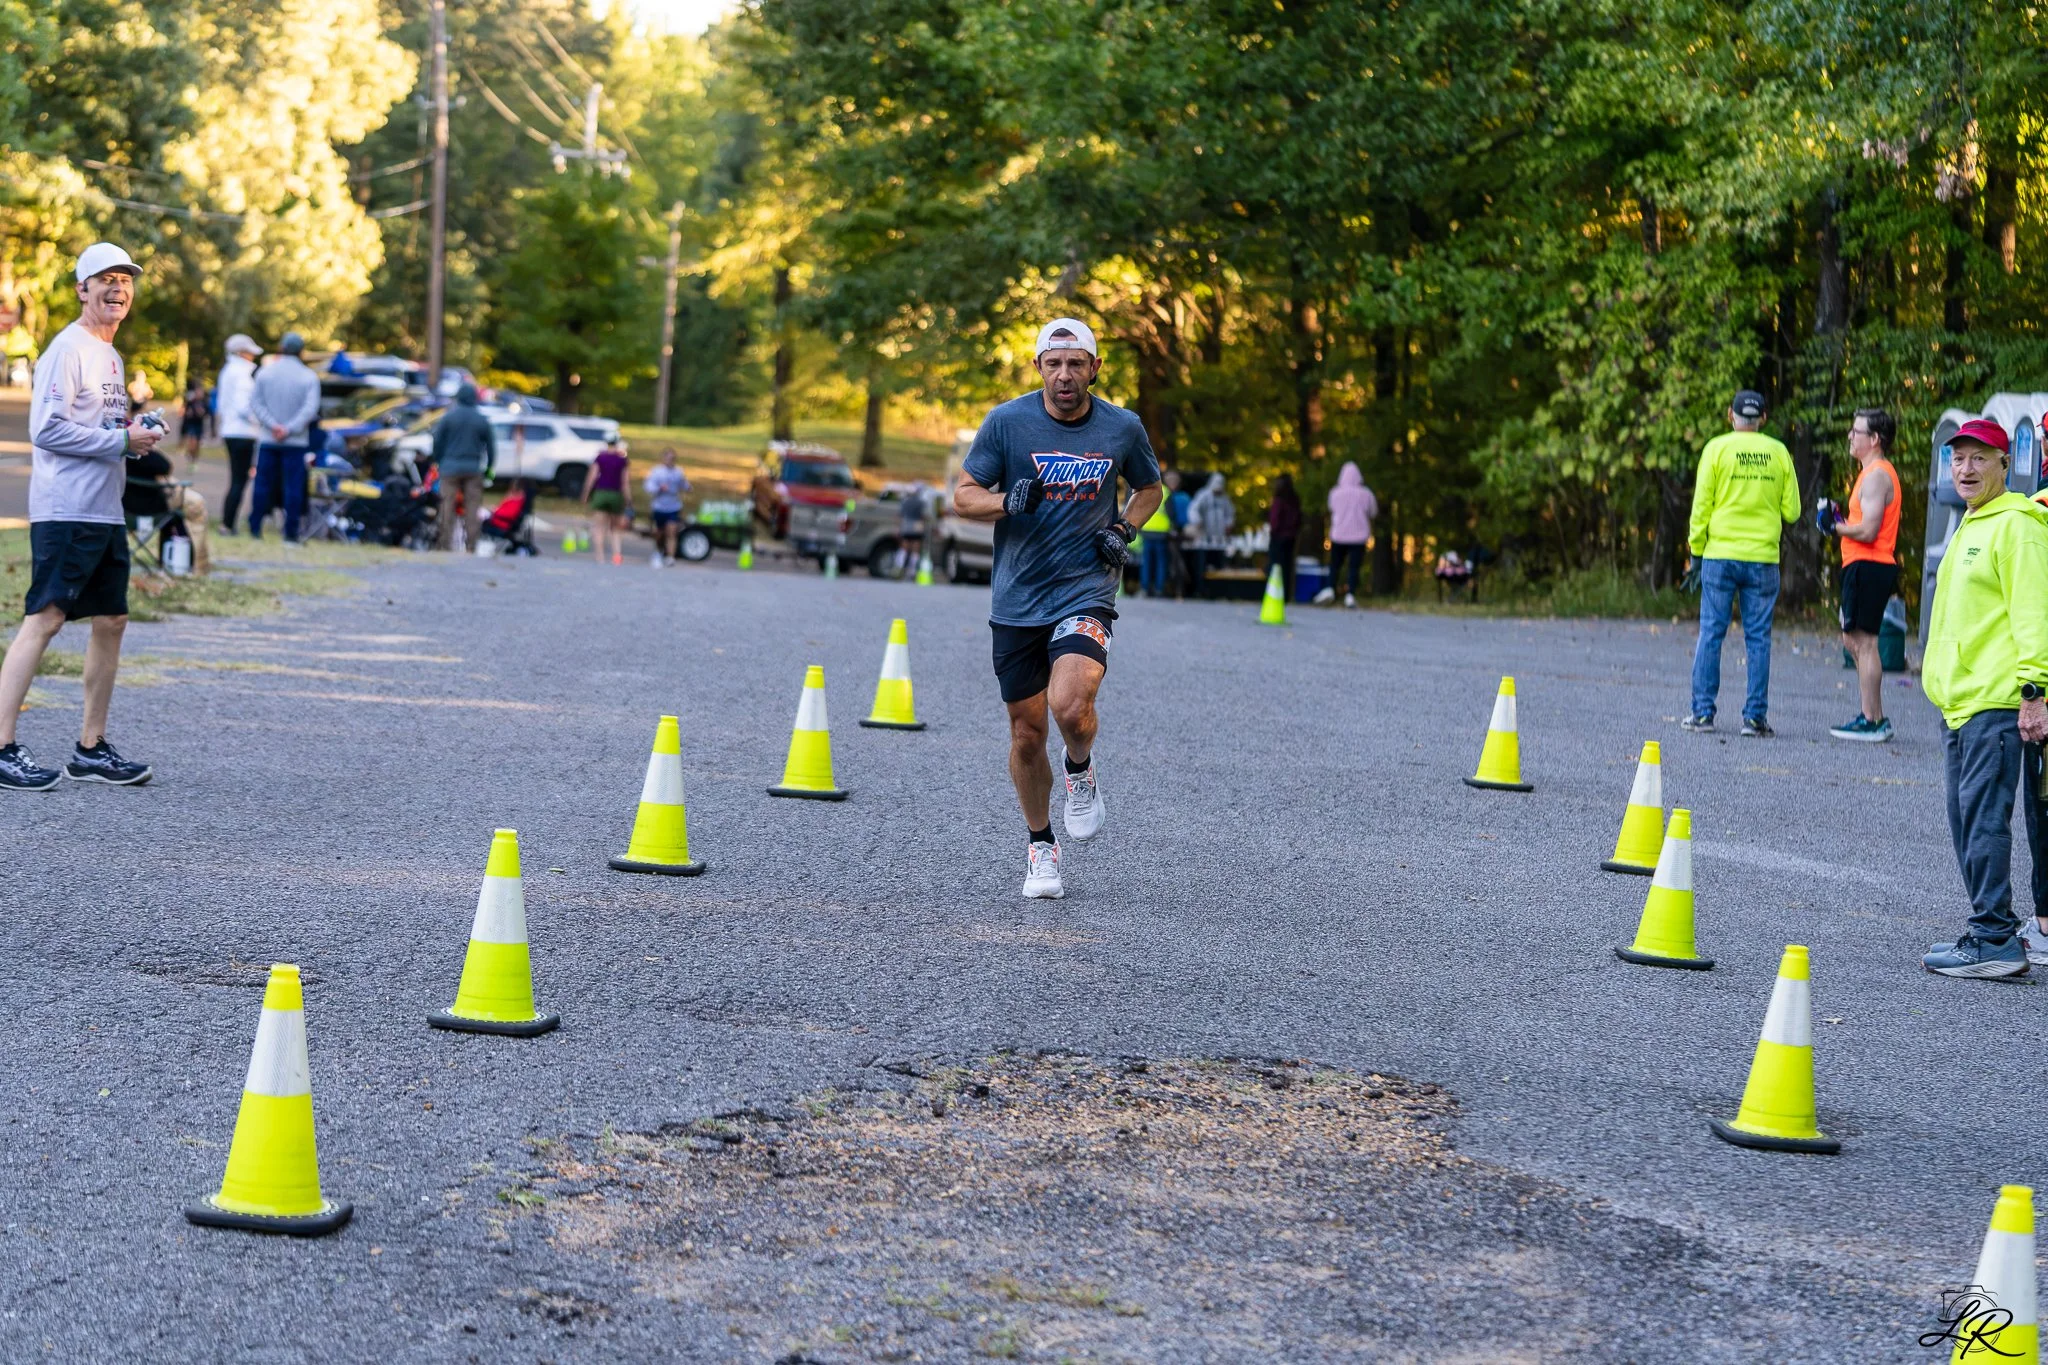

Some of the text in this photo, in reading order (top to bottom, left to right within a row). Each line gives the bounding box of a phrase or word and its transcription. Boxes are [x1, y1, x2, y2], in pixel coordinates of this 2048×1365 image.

[1031, 451, 1113, 493] THUNDER
[1045, 491, 1097, 501] RACING
[1074, 621, 1106, 647] 246
